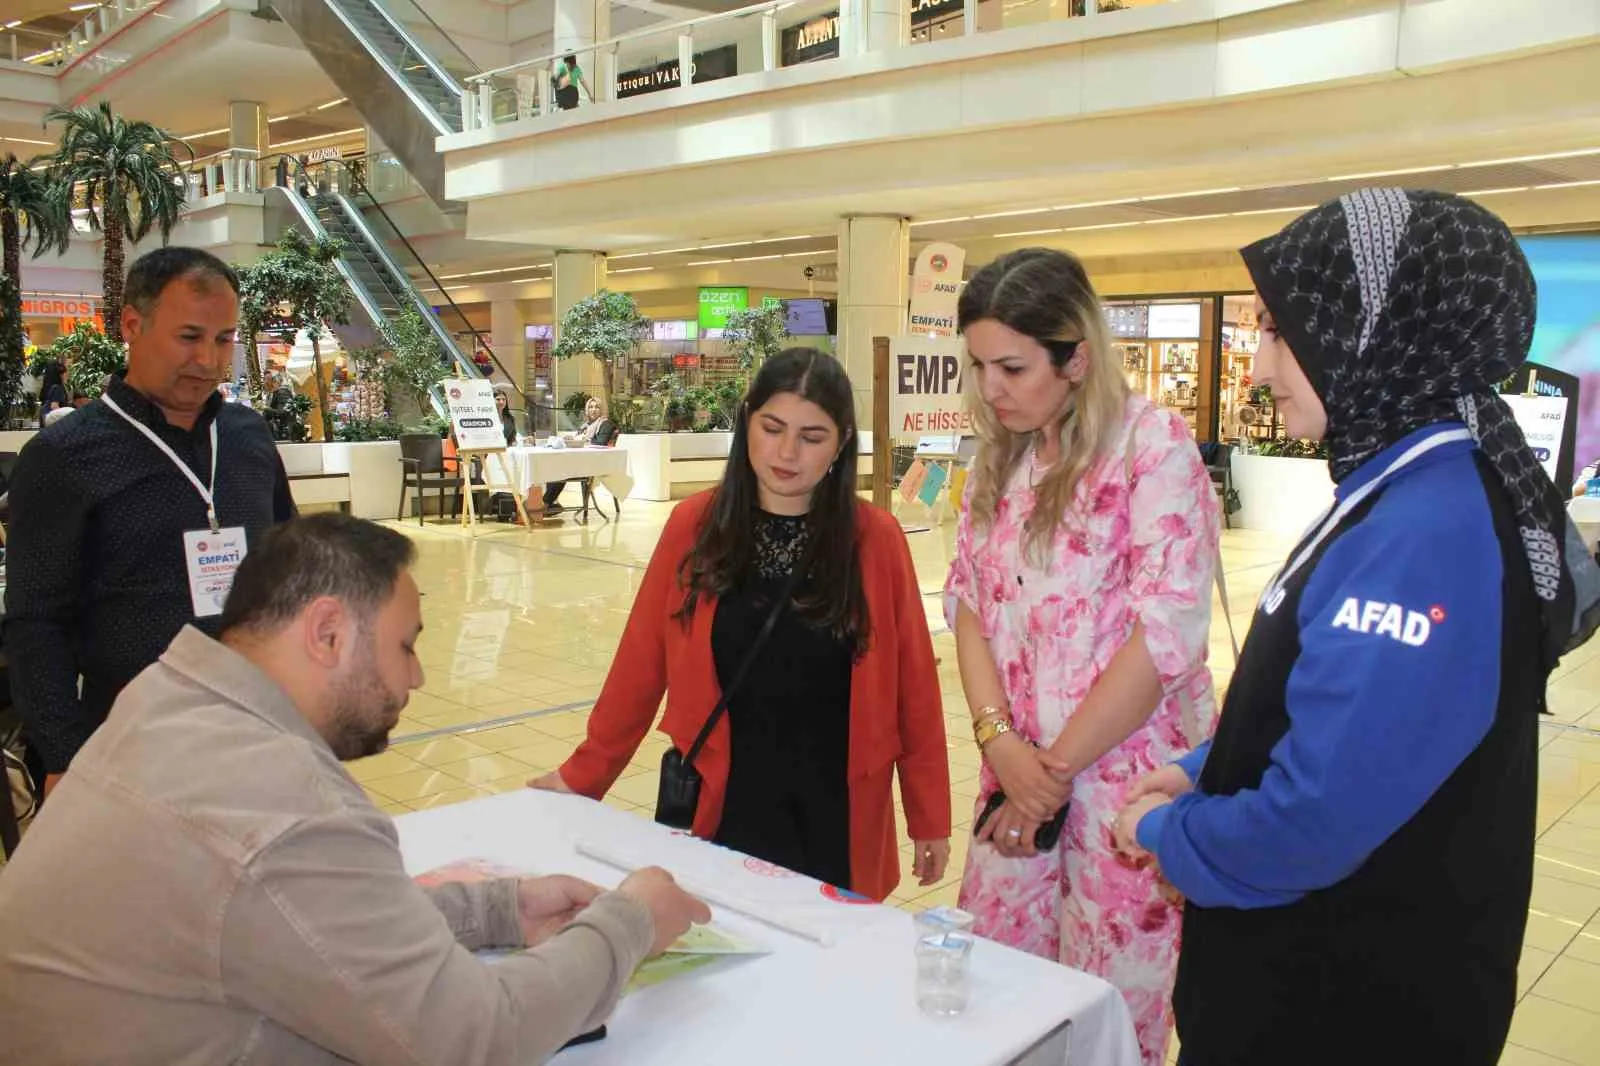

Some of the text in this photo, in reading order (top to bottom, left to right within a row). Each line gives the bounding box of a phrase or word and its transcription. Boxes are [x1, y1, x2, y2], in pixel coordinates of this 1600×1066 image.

[656, 62, 697, 85] VAKO
[897, 354, 962, 395] EMP
[903, 412, 924, 432] NE
[198, 550, 239, 565] EMPATİ
[1331, 597, 1431, 647] AFAD
